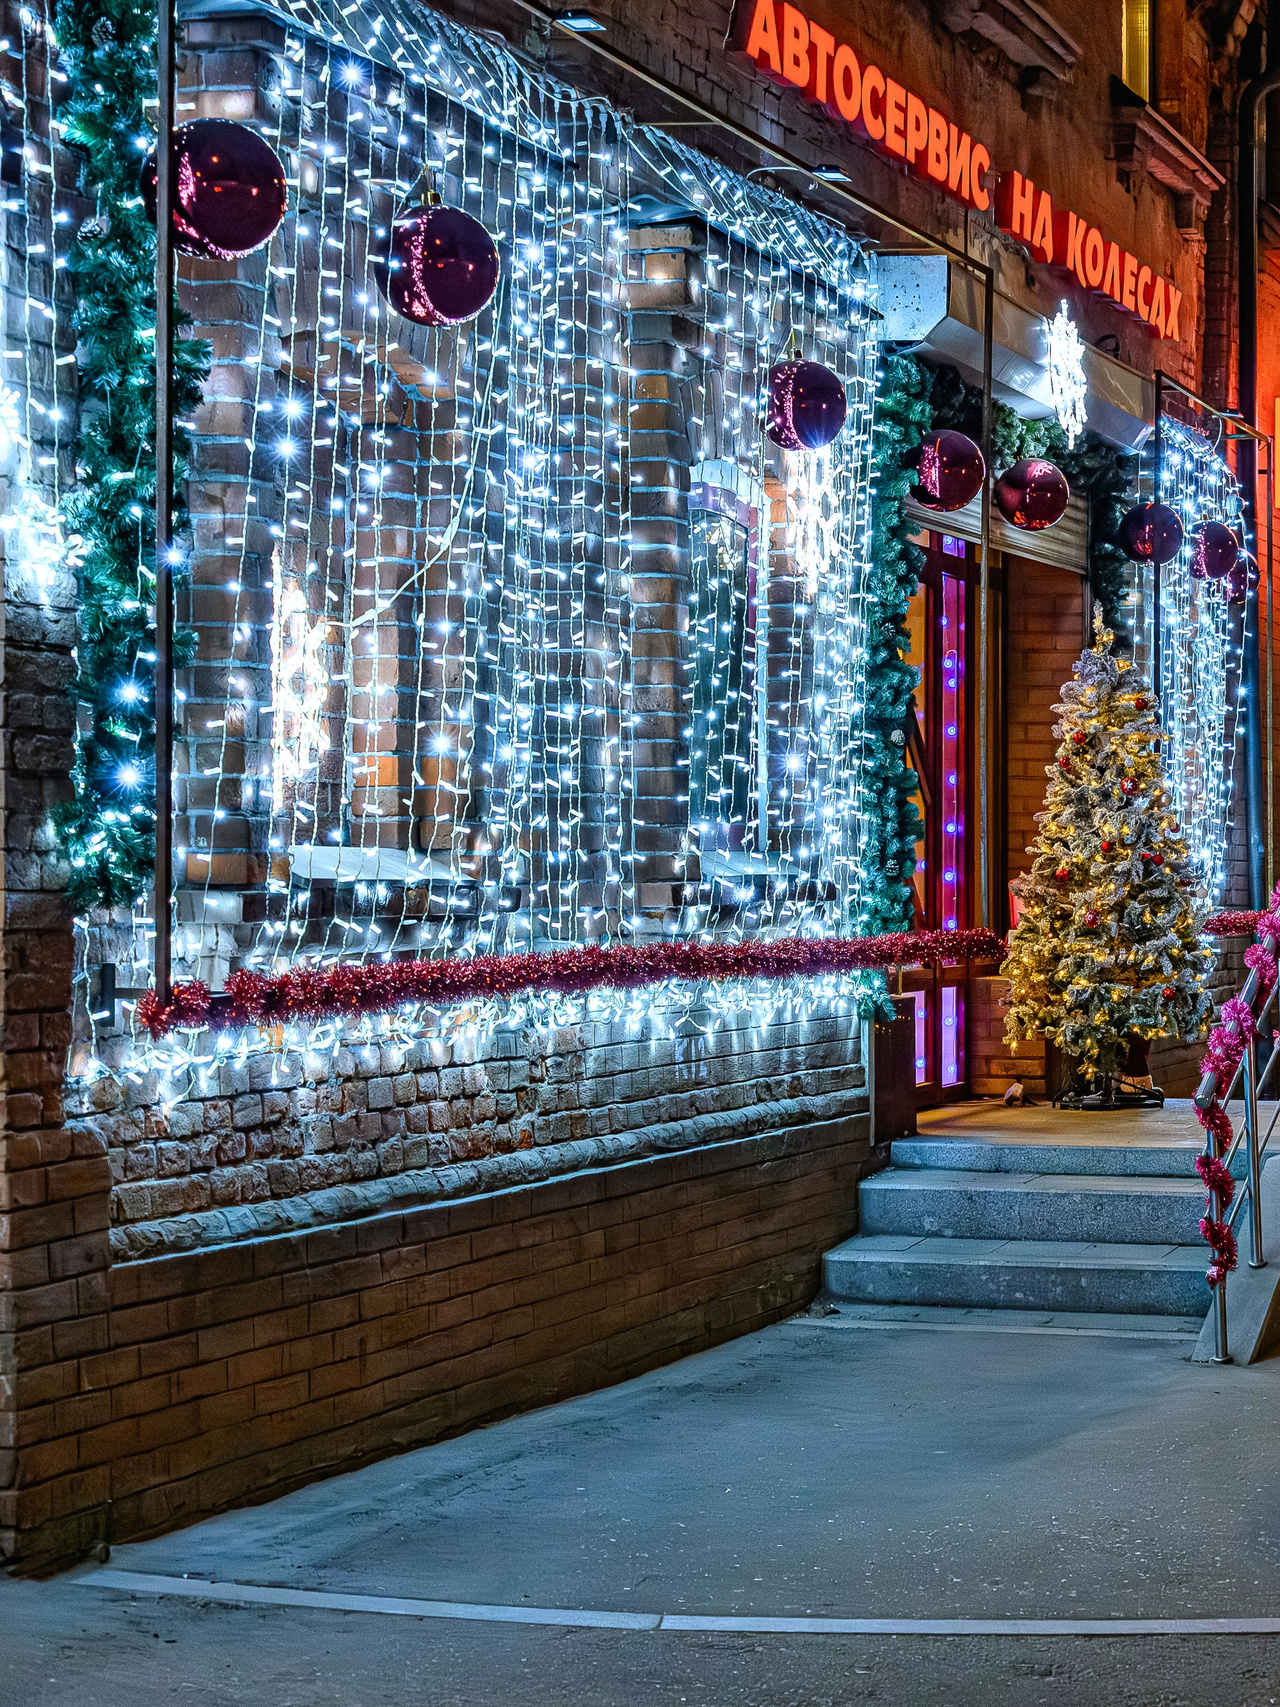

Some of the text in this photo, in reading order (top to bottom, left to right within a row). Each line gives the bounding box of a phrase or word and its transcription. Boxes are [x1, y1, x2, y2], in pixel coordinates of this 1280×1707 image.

[746, 0, 1183, 342] АВТОСЕРВИС НА КОЛЕСАХ
